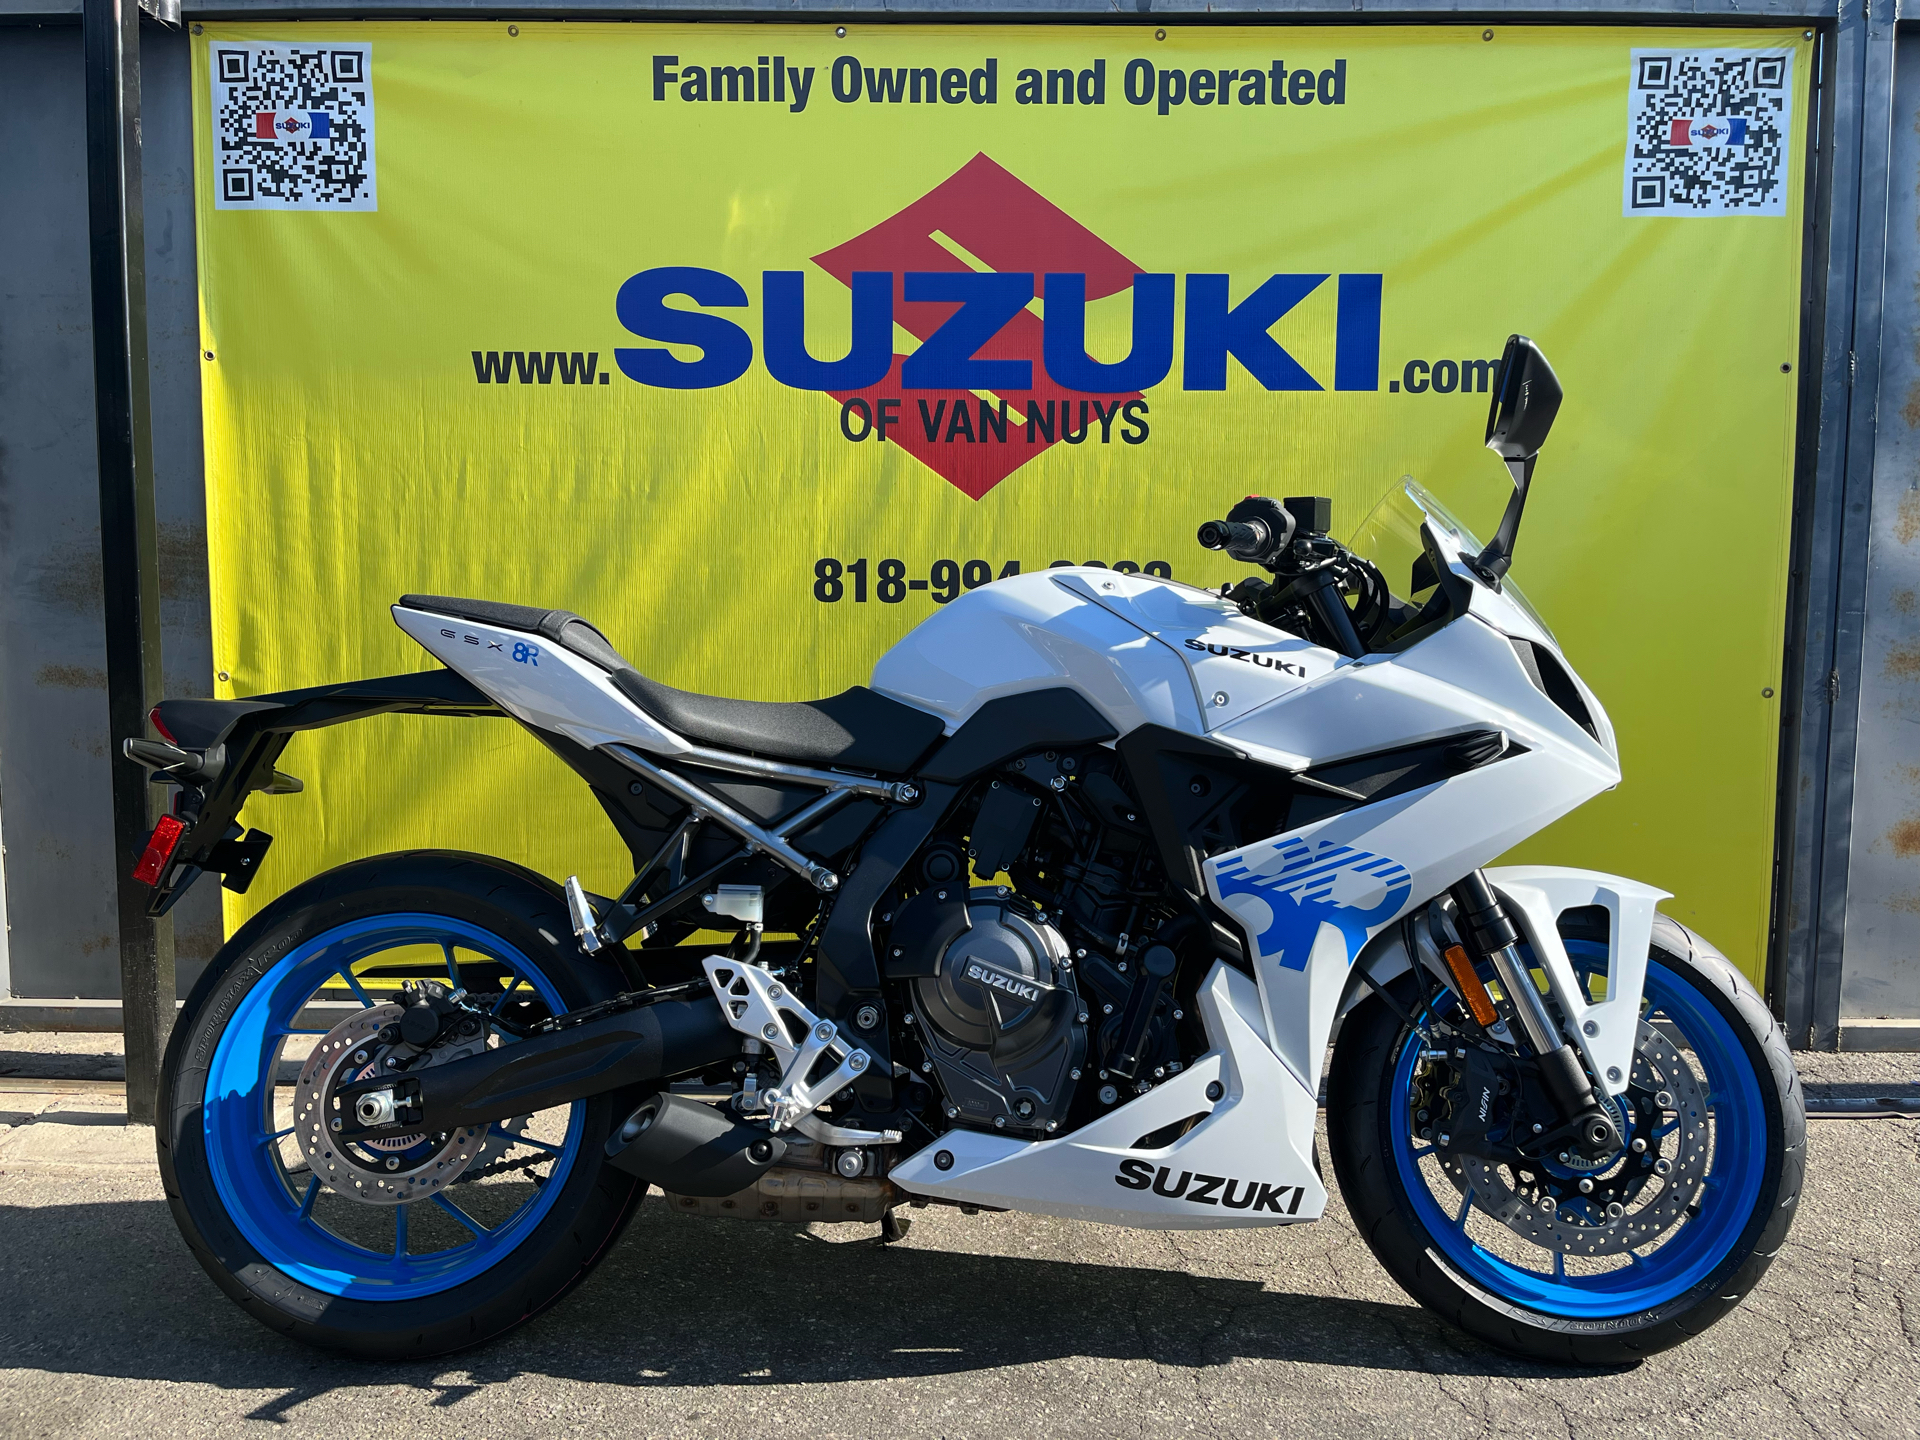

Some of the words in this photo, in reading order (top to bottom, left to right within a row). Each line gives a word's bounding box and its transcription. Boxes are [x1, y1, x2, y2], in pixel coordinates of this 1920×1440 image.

[652, 55, 815, 113] Family
[831, 55, 998, 105] Owned
[1015, 58, 1106, 105] and
[1124, 58, 1347, 115] Operated
[840, 398, 901, 442] OF
[917, 399, 1008, 443] VAN
[1027, 400, 1150, 445] NUYS
[1184, 638, 1306, 678] SUZUKI
[967, 964, 1040, 1002] SUZUKI
[1114, 1158, 1306, 1216] SUZUKI
